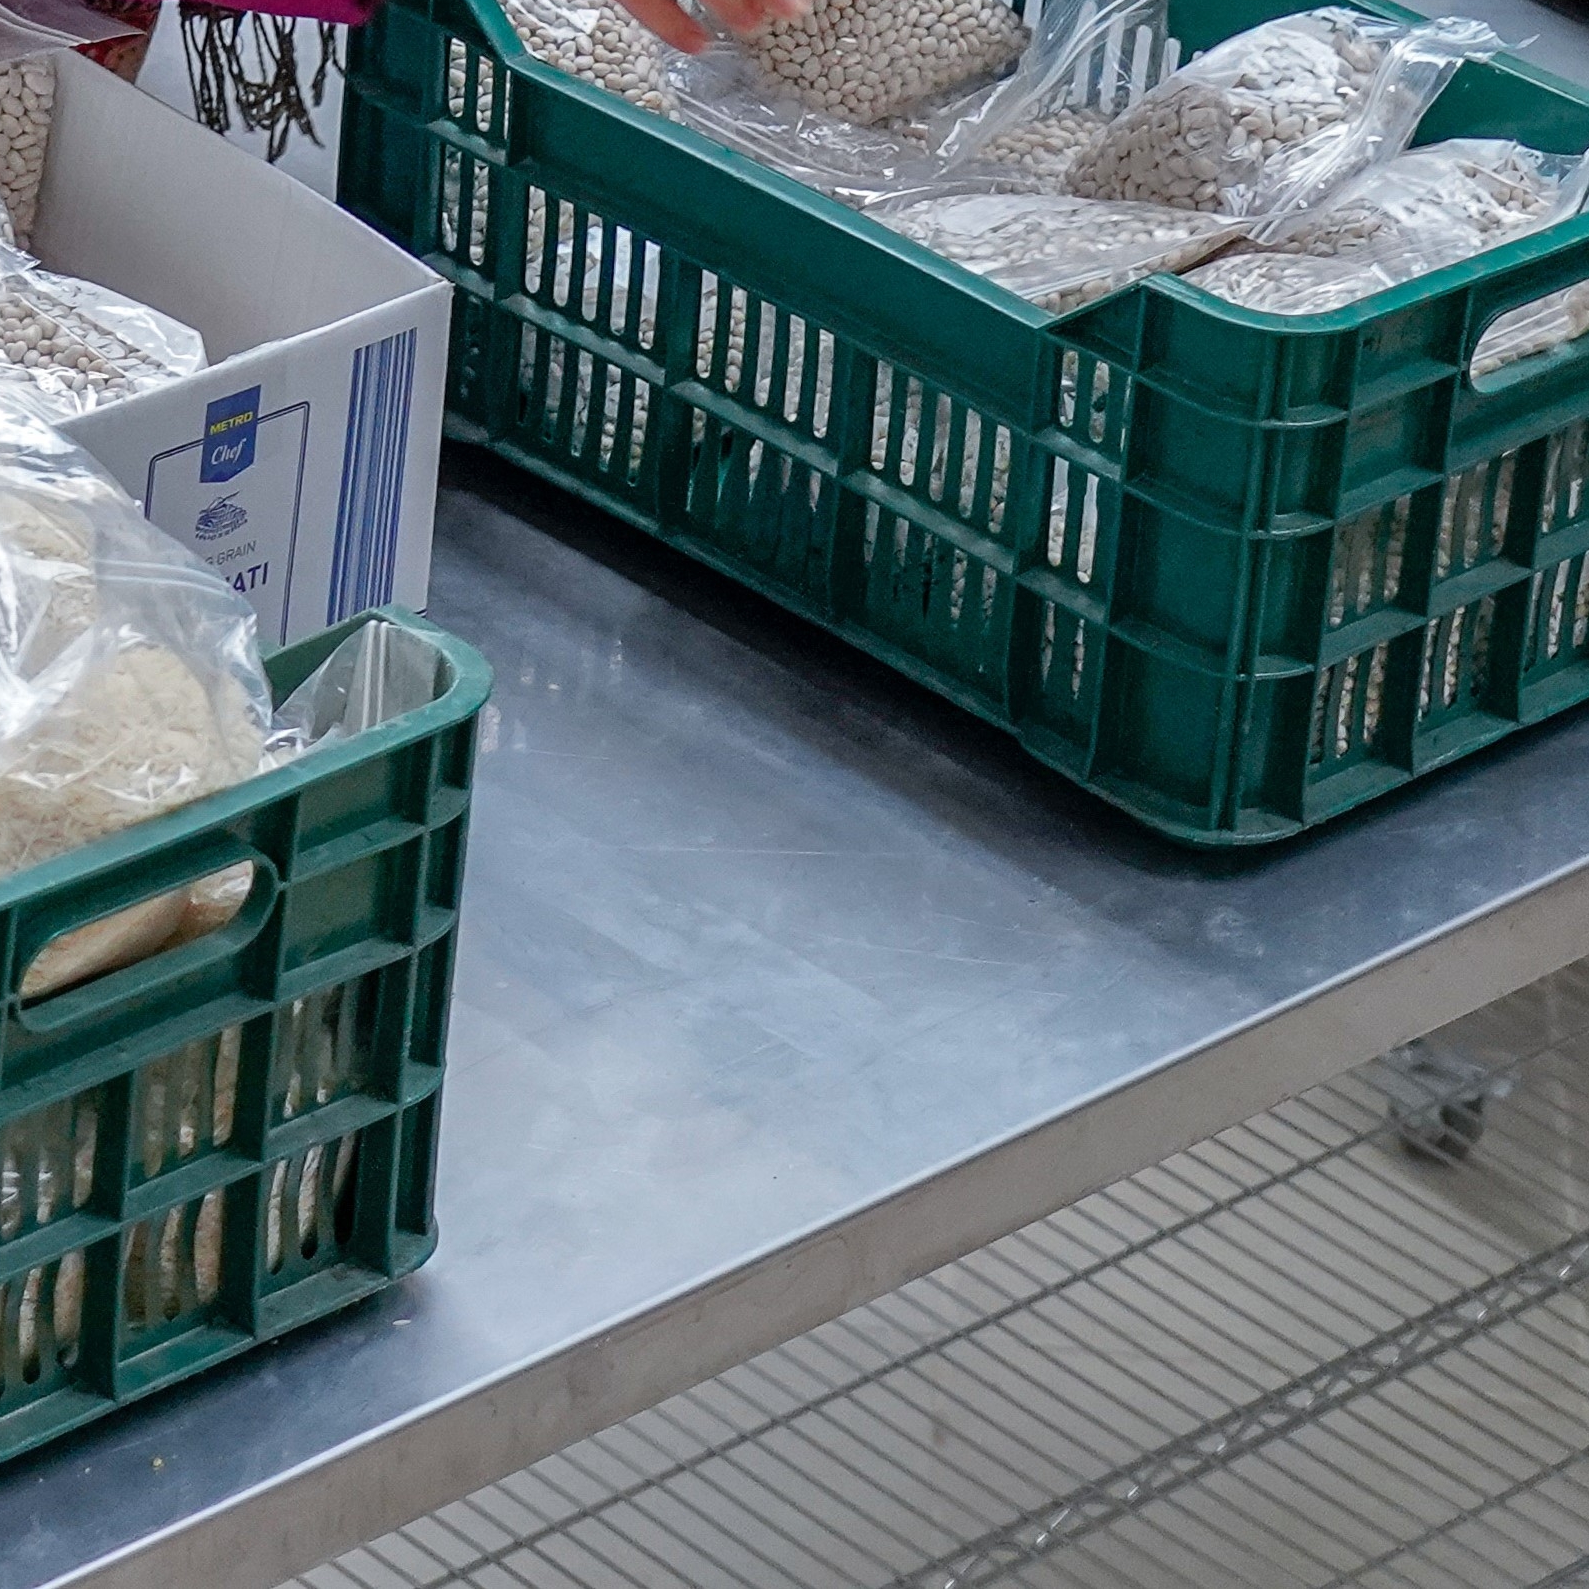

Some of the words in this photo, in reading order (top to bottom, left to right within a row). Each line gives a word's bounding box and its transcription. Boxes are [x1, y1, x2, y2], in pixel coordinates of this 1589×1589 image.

[209, 411, 254, 435] METRO
[211, 437, 247, 465] Chef
[216, 539, 257, 566] GRAIN
